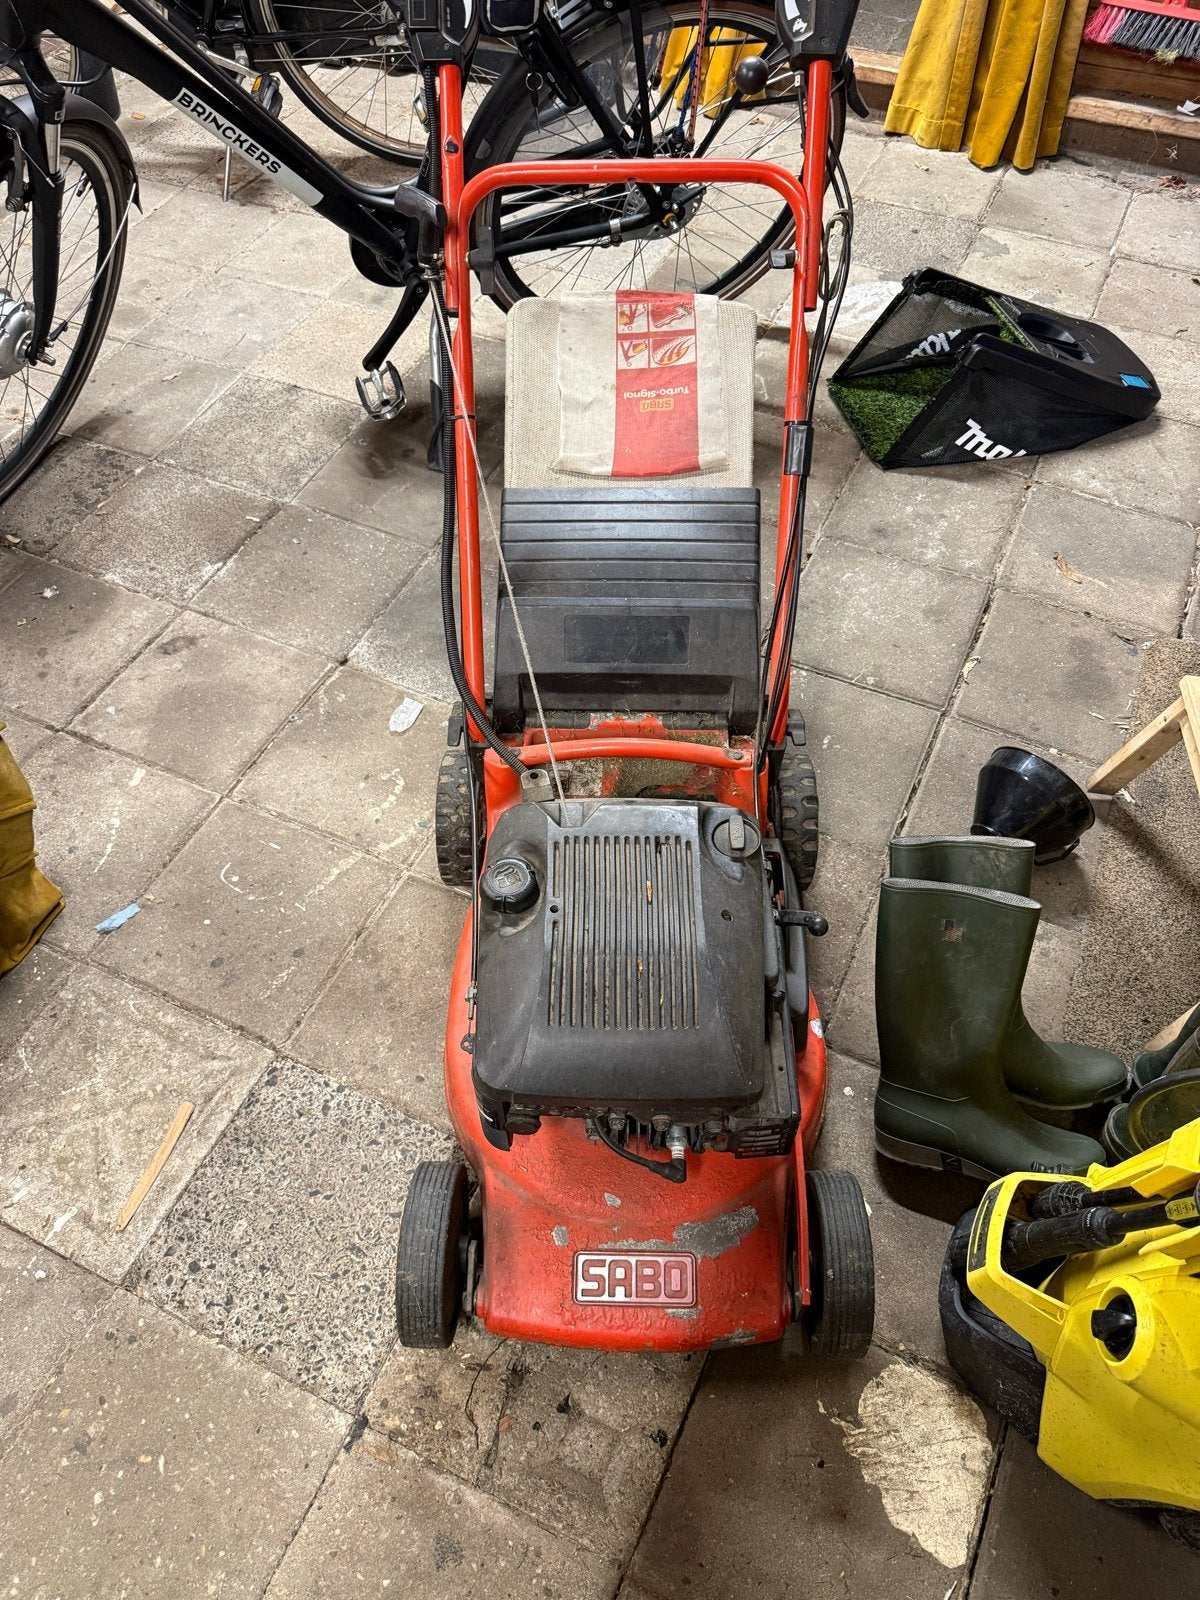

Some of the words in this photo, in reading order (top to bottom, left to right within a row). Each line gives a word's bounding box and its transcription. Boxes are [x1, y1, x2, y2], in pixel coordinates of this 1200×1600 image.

[177, 92, 282, 174] BRINCKERS
[624, 385, 690, 400] Turbo-Signal
[641, 399, 672, 411] SABO
[581, 1259, 688, 1299] SABO
